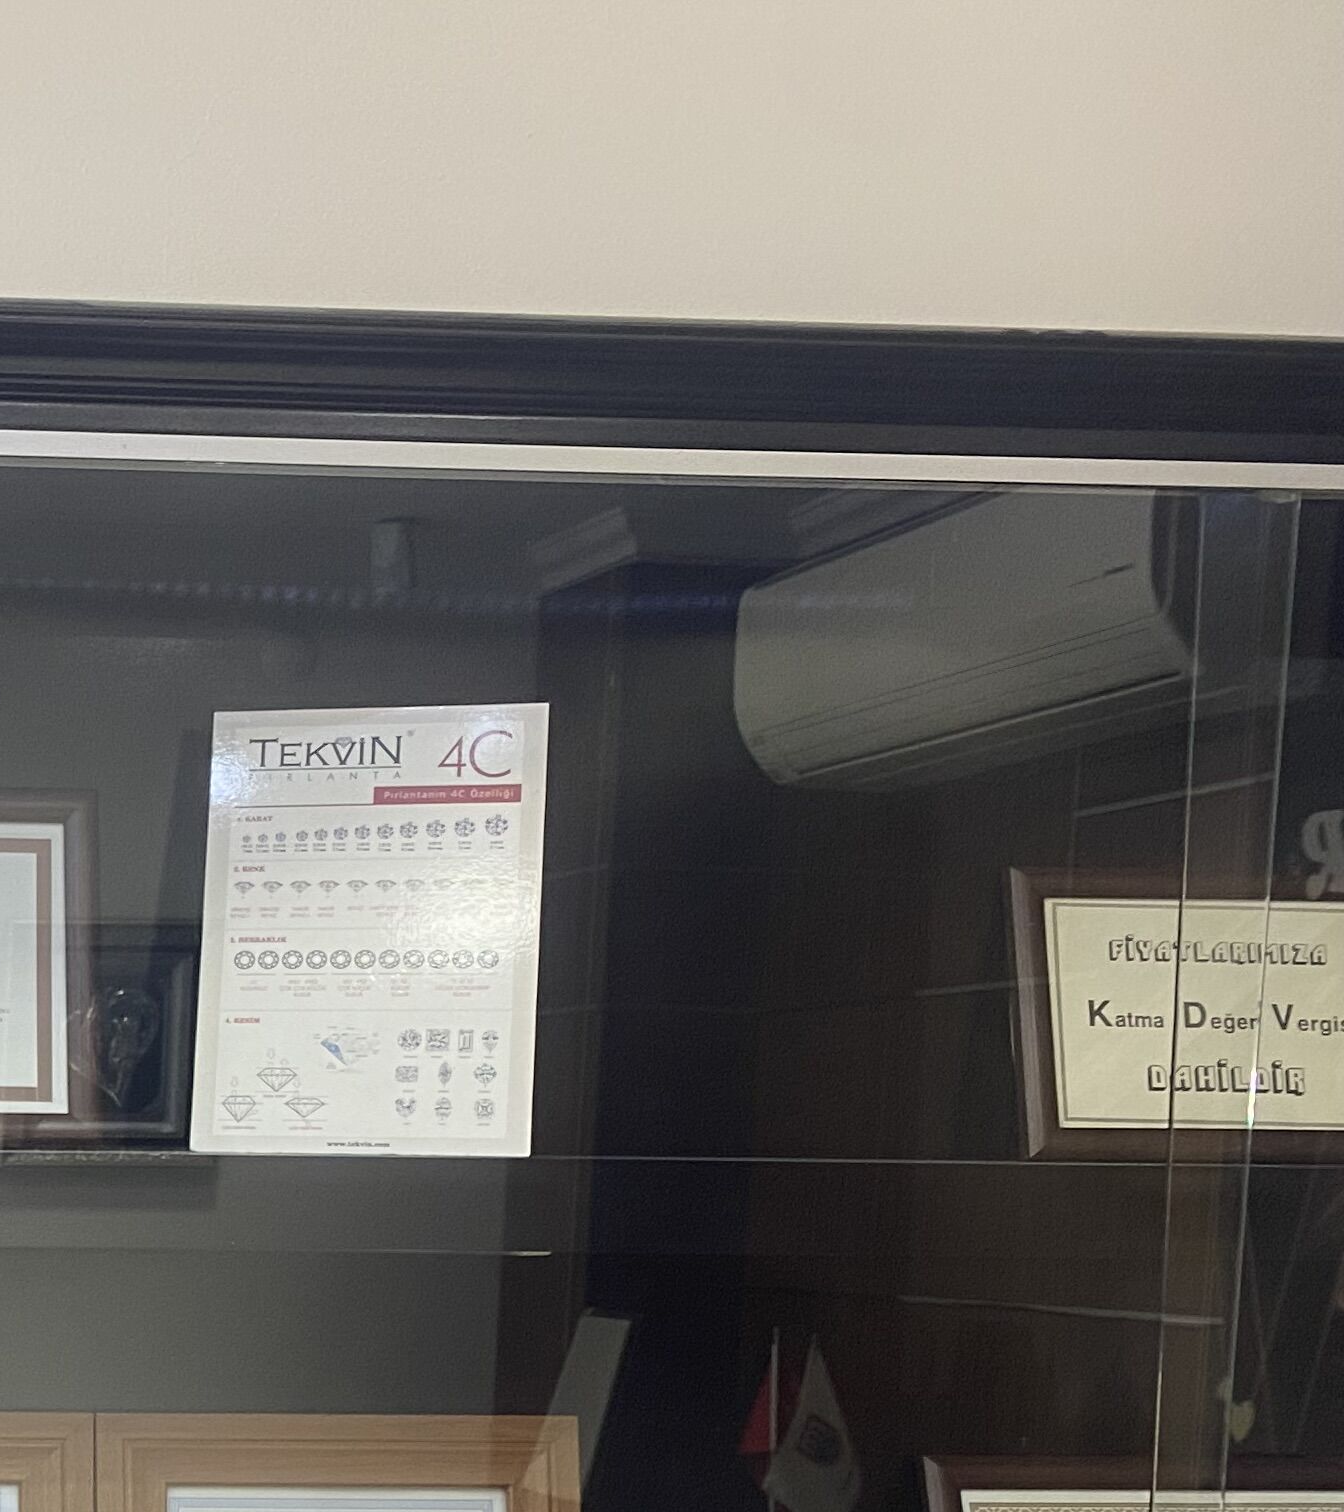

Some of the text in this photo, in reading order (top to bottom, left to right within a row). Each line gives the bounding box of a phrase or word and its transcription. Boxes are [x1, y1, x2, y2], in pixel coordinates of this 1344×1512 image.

[438, 730, 513, 778] 4C
[450, 789, 465, 798] 4C
[1087, 1000, 1165, 1029] Katma
[1183, 1002, 1259, 1033] Değer
